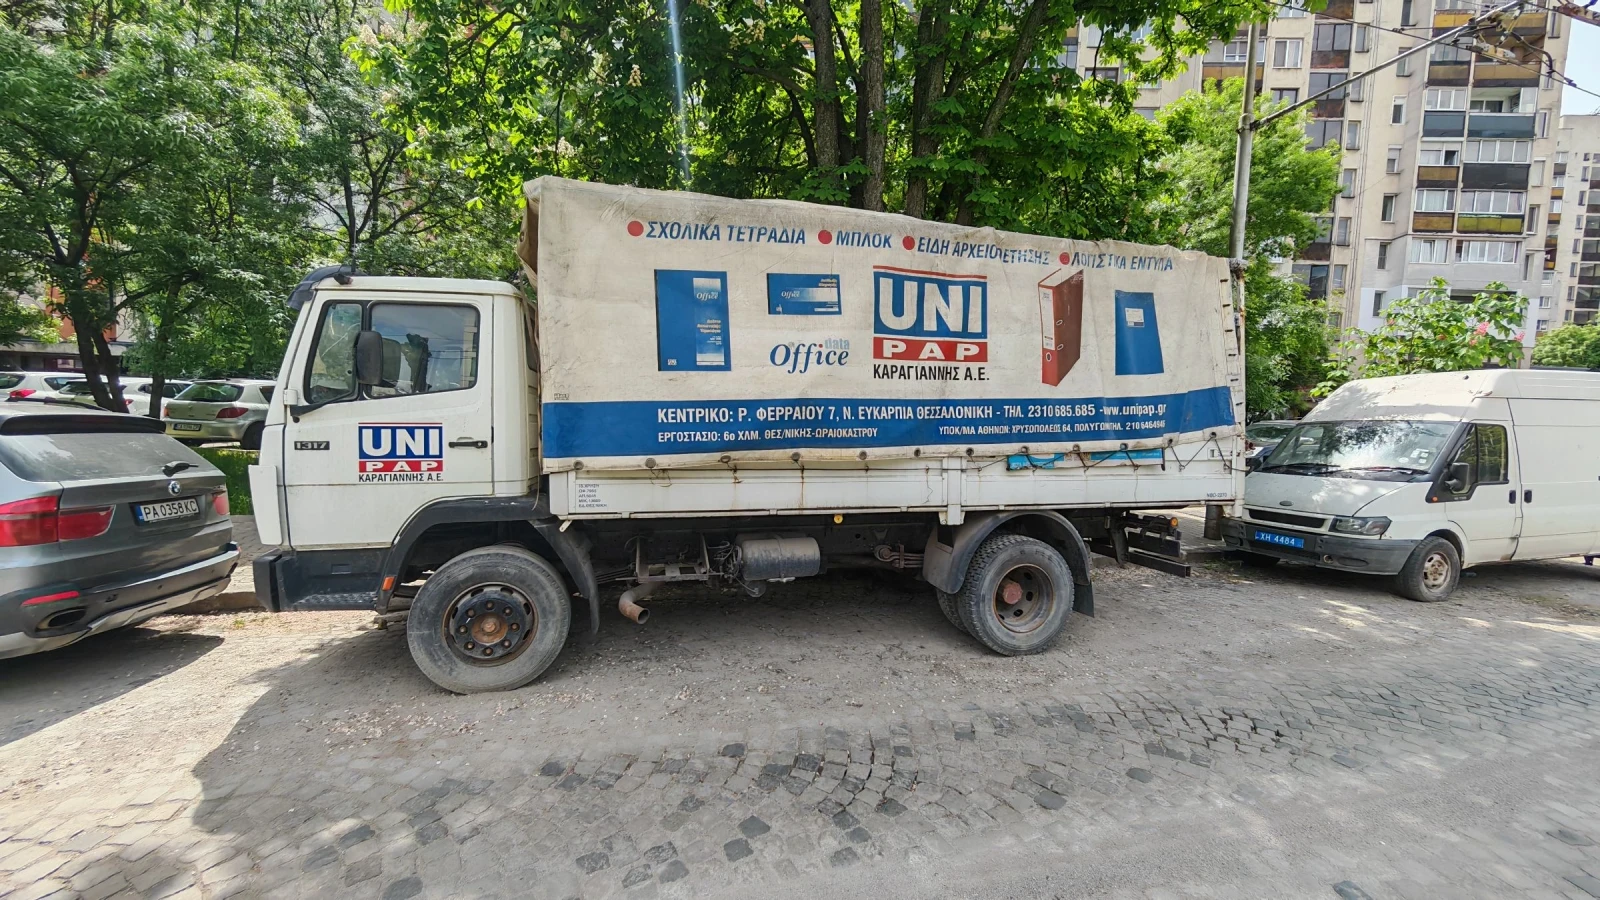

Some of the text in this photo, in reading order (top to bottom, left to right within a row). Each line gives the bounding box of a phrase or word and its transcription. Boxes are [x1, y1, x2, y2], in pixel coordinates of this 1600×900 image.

[646, 221, 806, 245] ΣΧΟΛΙΚΑ ΤΕΤΡΑΔΙΑ
[836, 230, 892, 249] ΜΠΛΟΚ
[917, 236, 950, 256] ΕΙΔΗ
[879, 277, 982, 334] UNI
[825, 338, 850, 350] data
[882, 340, 980, 361] PAP
[769, 343, 849, 374] Office
[873, 364, 990, 381] ΚΑΡΑΓΙΑΝΝΗΣ Α.Ε.
[657, 408, 733, 423] ΚΕΝΤΡΙΚΟ:
[756, 406, 824, 421] ΦΕΡΡΑΙΟΥ
[858, 406, 914, 420] ΕΥΚΑΡΠΙΑ
[917, 405, 993, 420] ΘΕΣΣΑΛΟΝΙΚΗ
[1003, 405, 1024, 419] ΤΗΛ.
[362, 428, 440, 456] UNI
[658, 431, 721, 442] ΕΡΓΟΣΤΑΣΙΟ:
[366, 461, 438, 471] PAP
[358, 473, 443, 482] ΚΑΡΑΓΙΑΝΝΗΣ Α.Ε.
